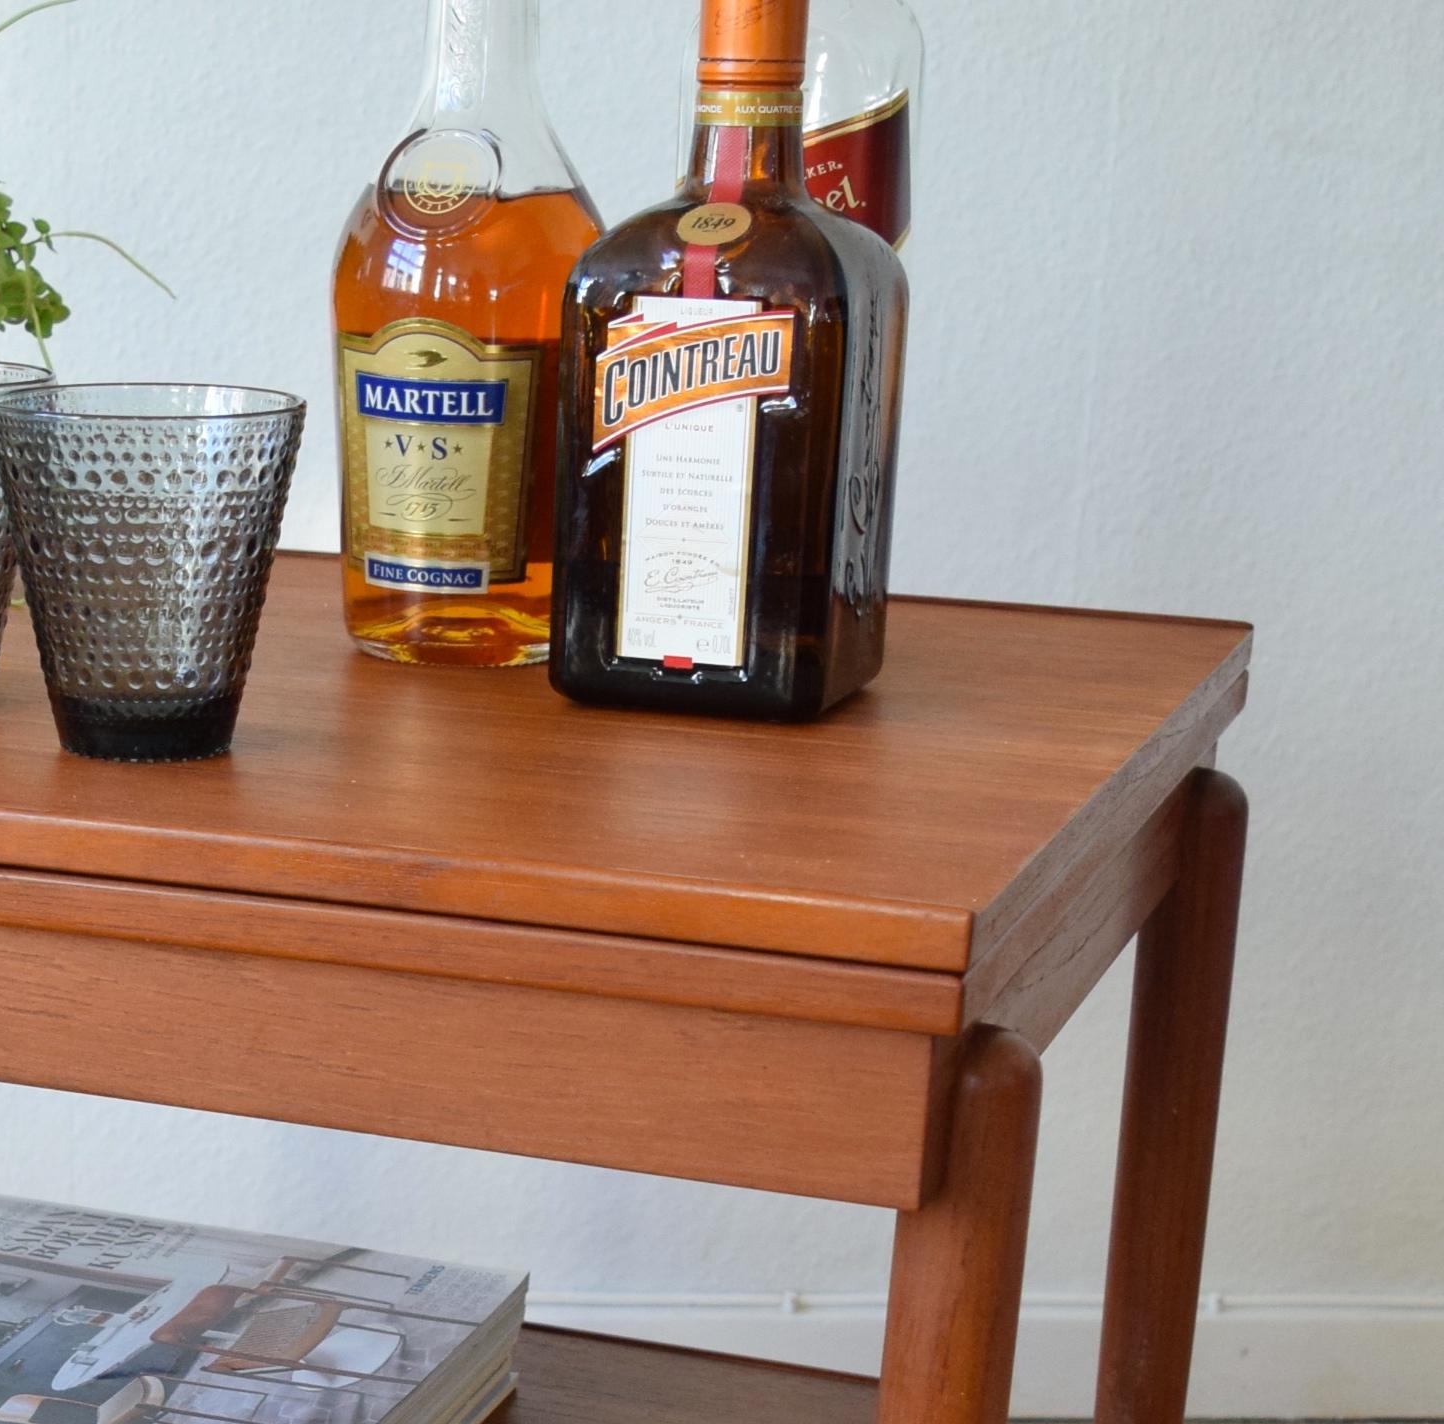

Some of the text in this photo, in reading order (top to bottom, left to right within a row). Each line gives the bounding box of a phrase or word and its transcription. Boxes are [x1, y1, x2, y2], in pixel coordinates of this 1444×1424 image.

[734, 105, 756, 113] AUX
[691, 216, 736, 230] 1849
[601, 329, 782, 427] COINTREAU
[364, 384, 494, 417] MARTELL
[373, 563, 476, 585] FINE COGNAC
